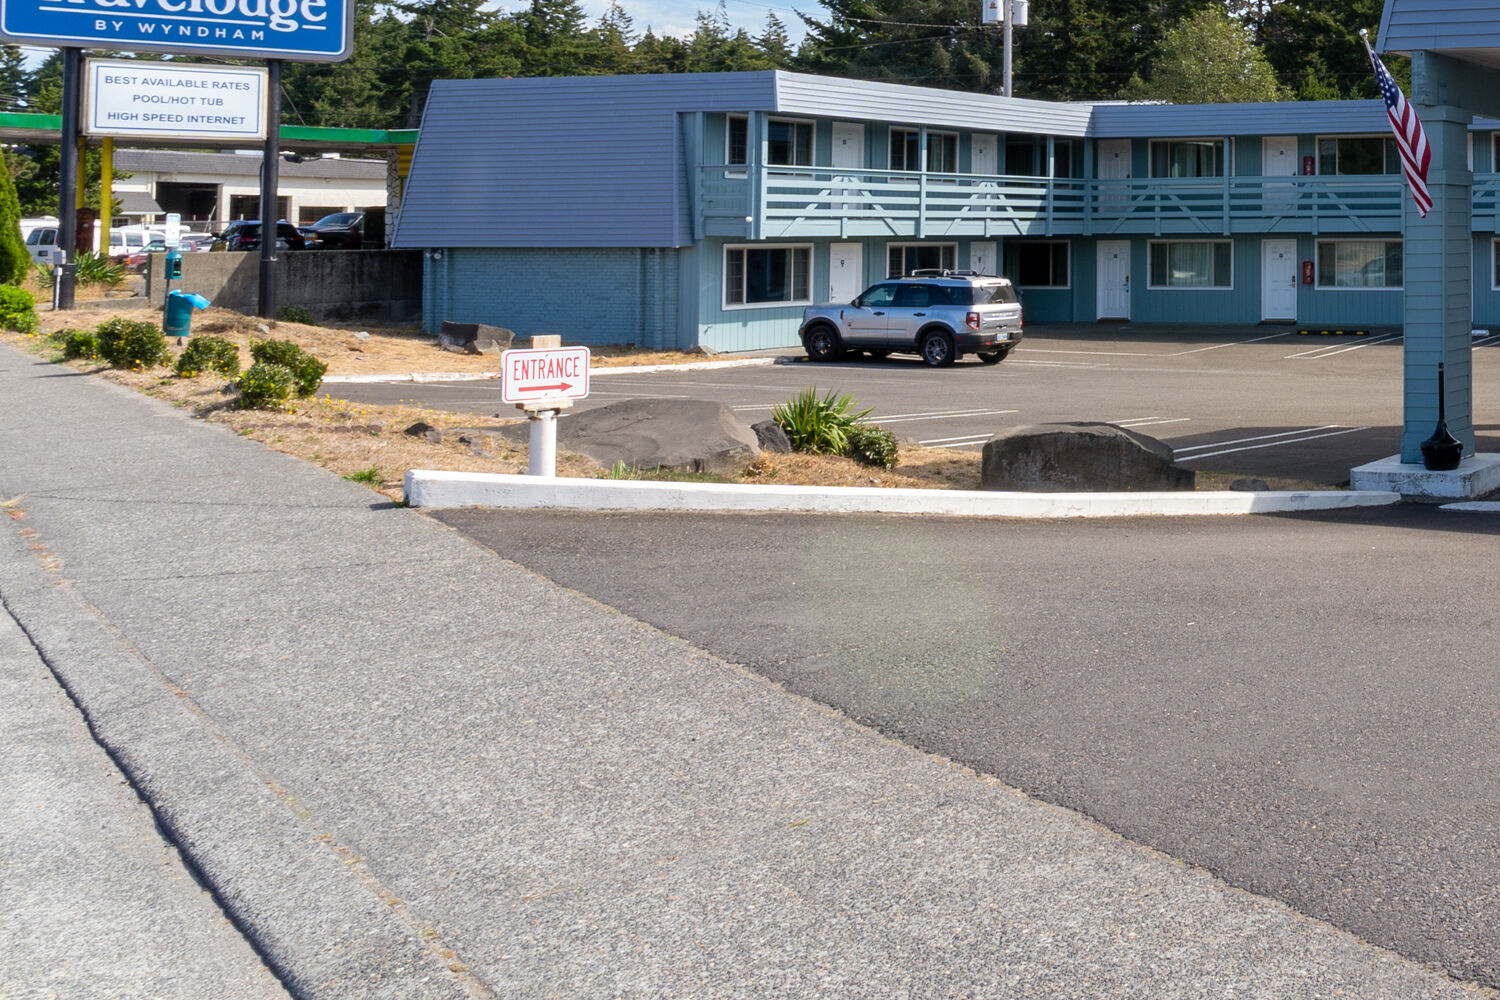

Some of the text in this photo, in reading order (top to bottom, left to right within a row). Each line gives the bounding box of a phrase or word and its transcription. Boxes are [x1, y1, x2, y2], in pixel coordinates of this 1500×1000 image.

[95, 19, 265, 41] BY WYNDHAM
[105, 75, 250, 91] BEST AVAILABLE RATES
[132, 94, 224, 106] POOL/HOT TUB
[107, 112, 246, 125] HIGH SPEED INTERNET
[513, 356, 580, 381] ENTRANCE
